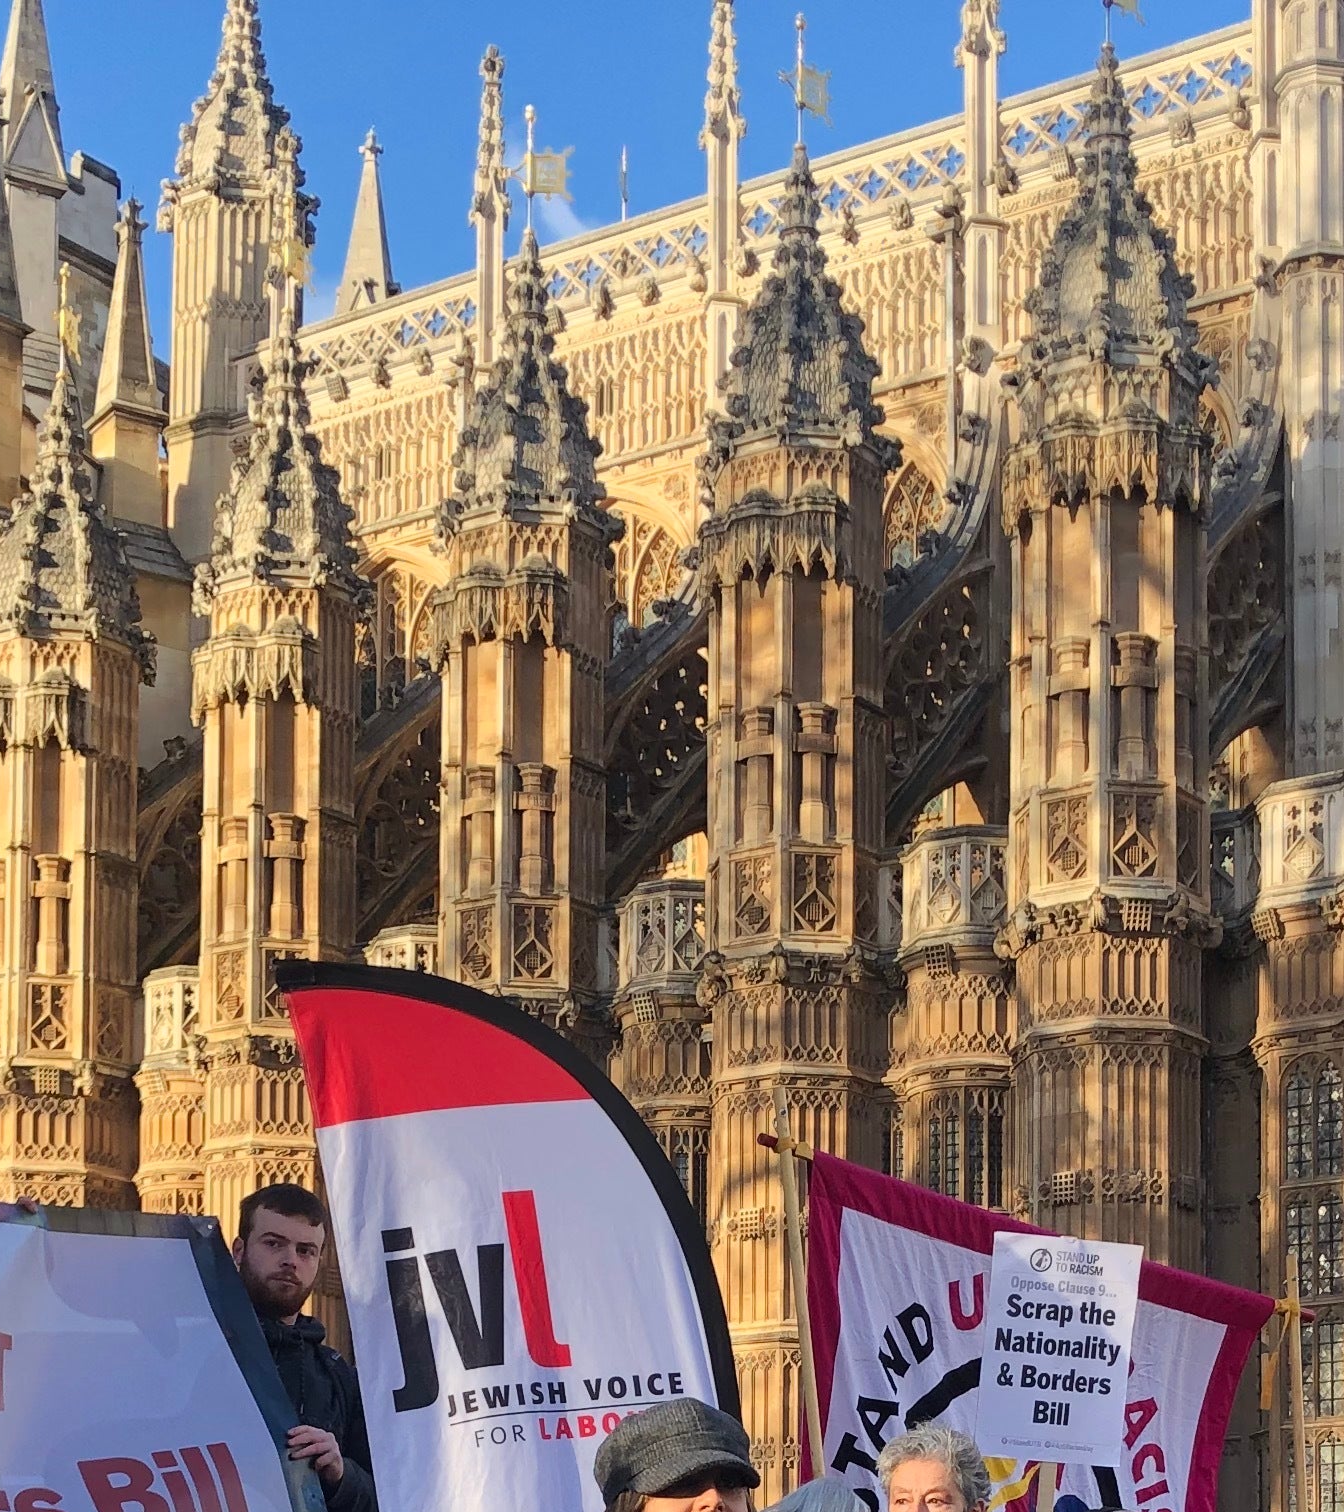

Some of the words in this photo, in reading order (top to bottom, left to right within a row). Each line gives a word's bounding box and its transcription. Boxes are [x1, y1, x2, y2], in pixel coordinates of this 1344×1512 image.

[1056, 1251, 1084, 1264] STAND
[1086, 1254, 1100, 1264] UP
[1056, 1262, 1067, 1273] TO
[1069, 1263, 1103, 1276] RACISM
[381, 1190, 571, 1413] jvl
[1011, 1276, 1054, 1292] Oppose
[1058, 1280, 1095, 1296] Clause
[1006, 1293, 1073, 1328] Scrap
[1080, 1301, 1116, 1326] the
[995, 1327, 1121, 1367] Nationality
[447, 1381, 567, 1418] JEWISH
[583, 1372, 684, 1400] VOICE
[996, 1362, 1014, 1387] &
[1020, 1365, 1111, 1395] Borders
[474, 1424, 526, 1448] FOR
[538, 1410, 646, 1440] LABO
[1033, 1400, 1070, 1426] Bill
